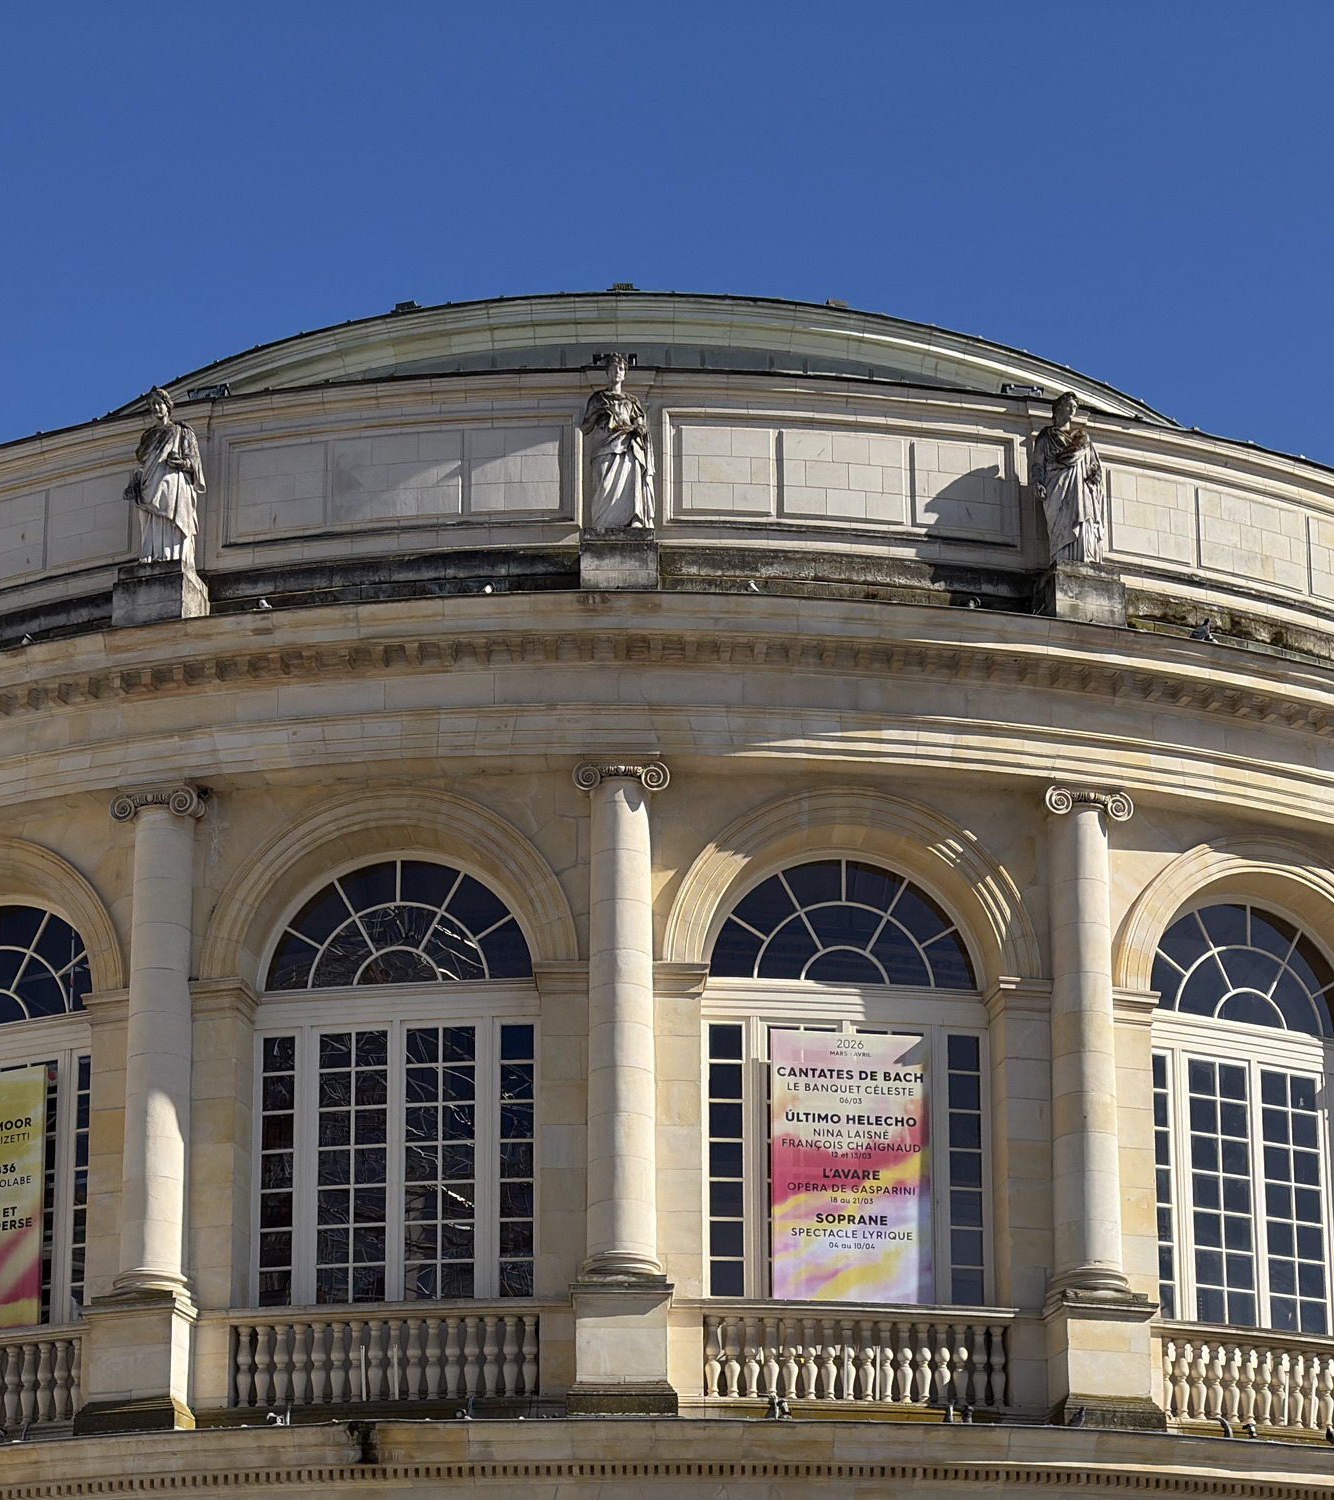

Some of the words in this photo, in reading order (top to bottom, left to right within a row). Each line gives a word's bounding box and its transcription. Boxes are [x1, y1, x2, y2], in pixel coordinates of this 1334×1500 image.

[836, 1039, 864, 1050] 2026
[776, 1066, 854, 1080] CANTATES
[859, 1070, 878, 1081] DE
[883, 1071, 924, 1083] BACH
[787, 1082, 799, 1091] LE
[804, 1083, 862, 1094] BANQUET
[864, 1084, 914, 1096] CÉLESTE
[839, 1097, 862, 1105] 06/03
[785, 1109, 841, 1124] ÚLTIMO
[846, 1114, 917, 1127] HELECHO
[813, 1128, 844, 1138] NINA
[847, 1129, 889, 1140] LAISNÉ
[782, 1138, 843, 1151] FRANÇOIS
[847, 1141, 921, 1153] CHAIGNAUD
[851, 1152, 872, 1160] 13/03
[823, 1168, 881, 1181] L'AVARE
[787, 1181, 828, 1192] OPÉRA
[831, 1183, 847, 1193] DE
[851, 1184, 916, 1196] GASPARINI
[852, 1197, 874, 1205] 21/03
[2, 1206, 18, 1218] ET
[815, 1212, 888, 1226] SOPRANE
[791, 1227, 858, 1239] SPECTACLE
[862, 1230, 913, 1241] LYRIQUE
[828, 1241, 839, 1249] 04
[854, 1242, 875, 1250] 10/04
